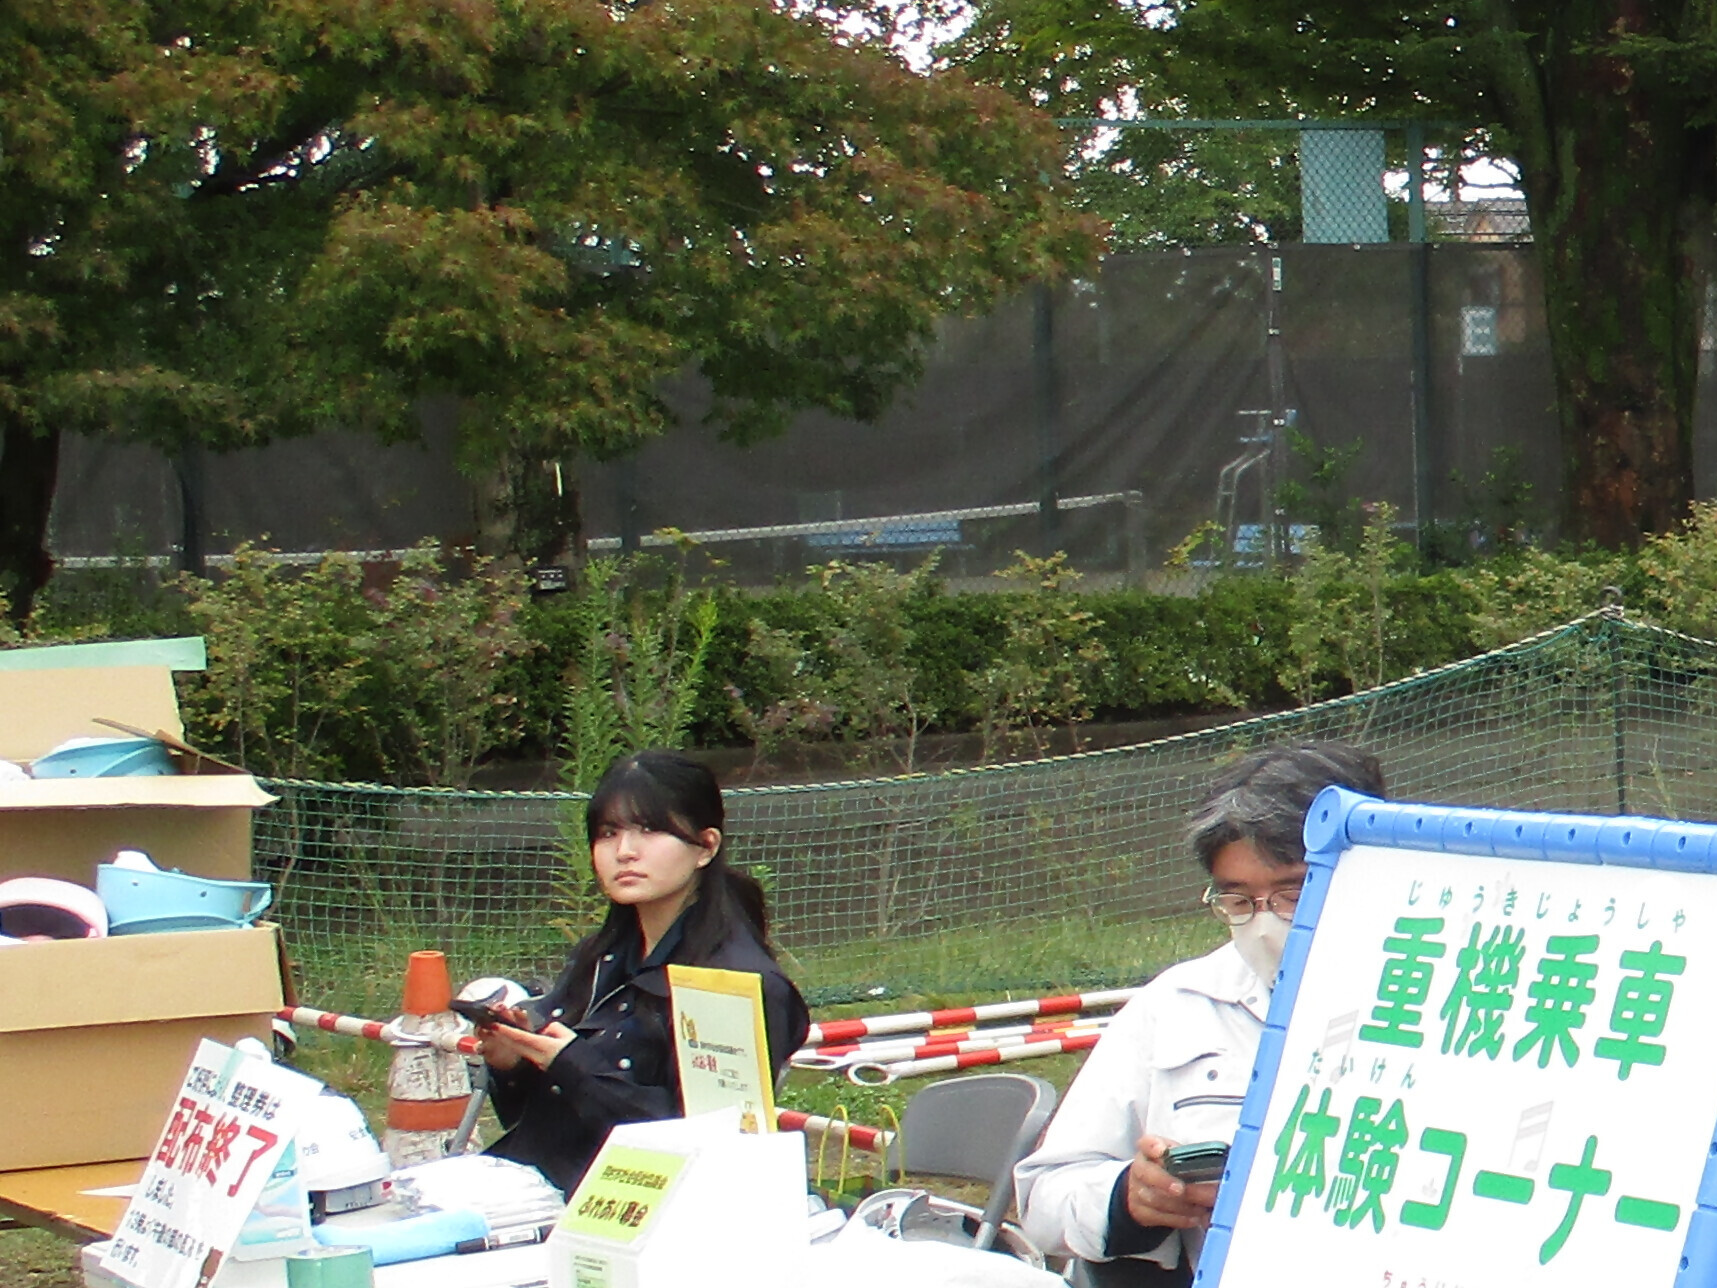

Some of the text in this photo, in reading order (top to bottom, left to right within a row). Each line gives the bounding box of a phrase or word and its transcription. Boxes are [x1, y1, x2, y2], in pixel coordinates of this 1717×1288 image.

[1359, 917, 1687, 1081] 重機乗車
[1307, 1047, 1417, 1090] たいけん
[156, 1096, 279, 1198] 配布終了
[1264, 1083, 1682, 1265] 体験コーナー
